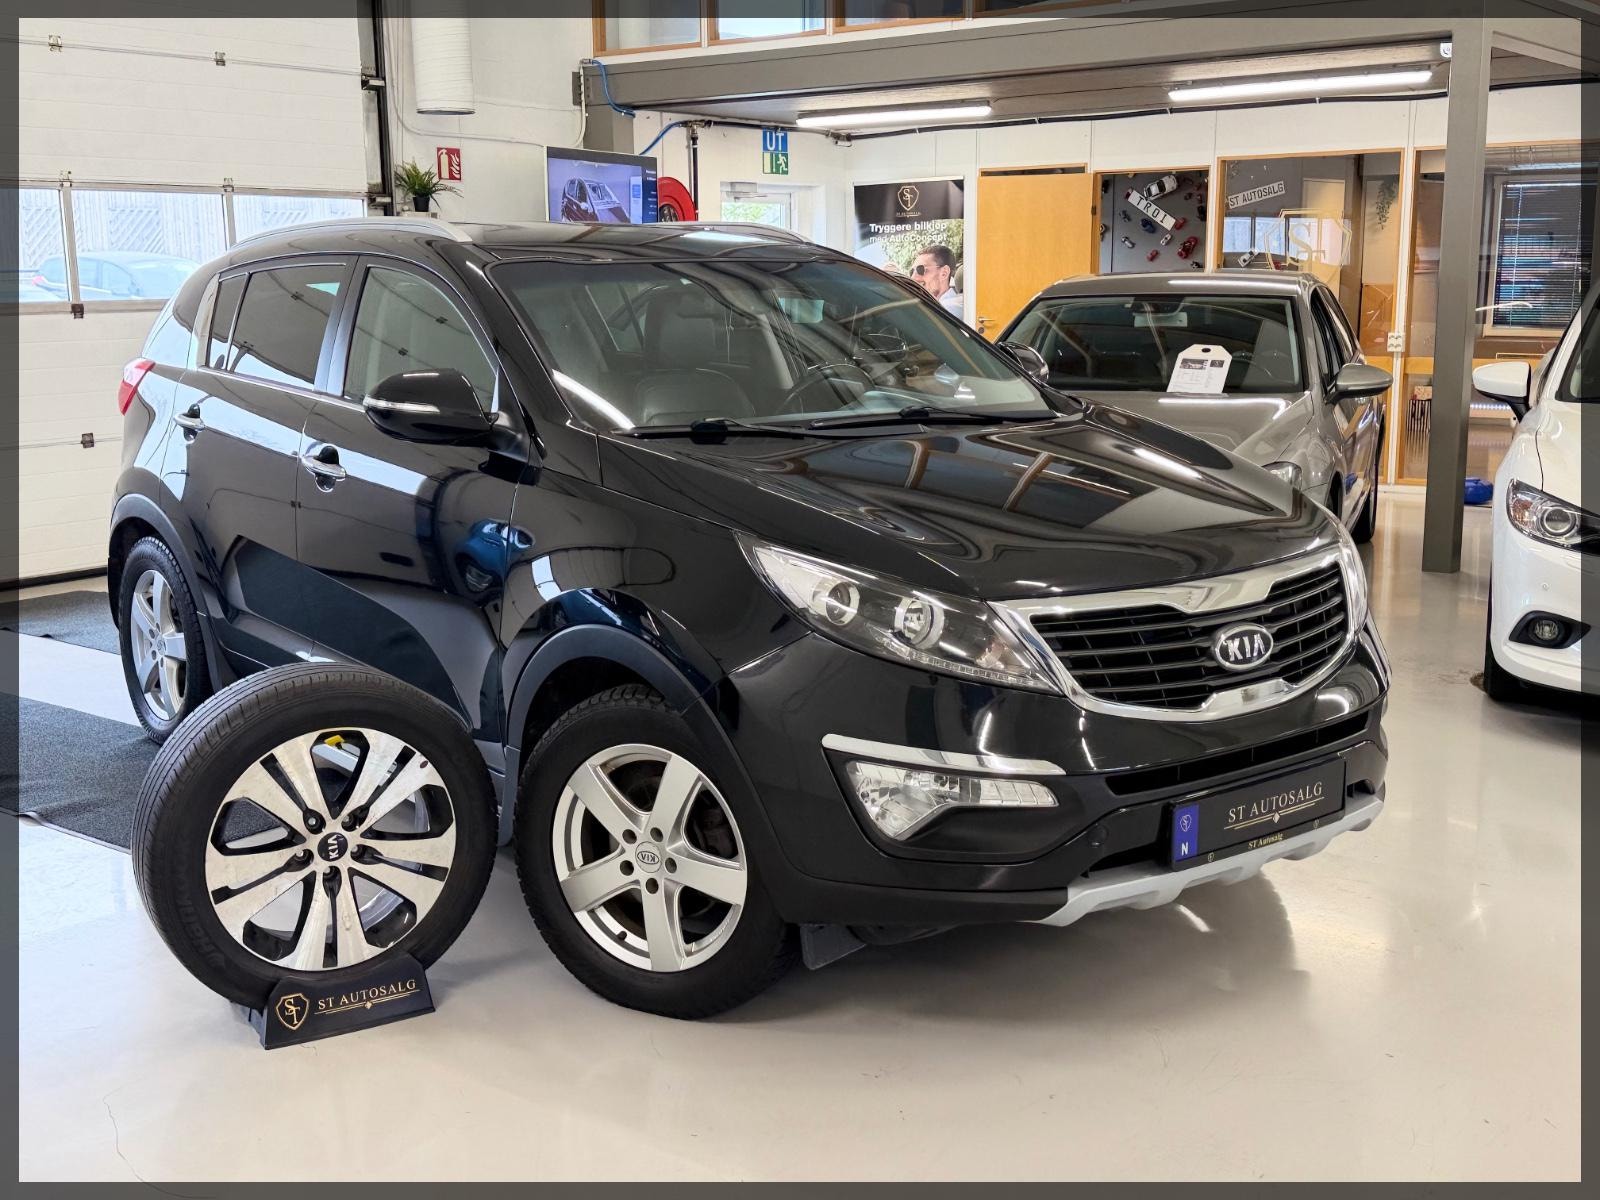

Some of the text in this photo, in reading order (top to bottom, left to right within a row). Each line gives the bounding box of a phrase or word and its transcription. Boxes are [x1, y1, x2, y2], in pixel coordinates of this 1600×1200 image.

[766, 131, 785, 151] UT
[1229, 183, 1284, 207] ST AUTOSALG
[869, 223, 912, 233] Tryggere
[1225, 633, 1266, 661] KIA
[1228, 781, 1323, 824] ST AUTOSALG
[327, 834, 339, 859] KIA
[640, 852, 656, 862] KIA
[1181, 842, 1189, 856] N
[318, 979, 416, 1010] ST AUTOSALG
